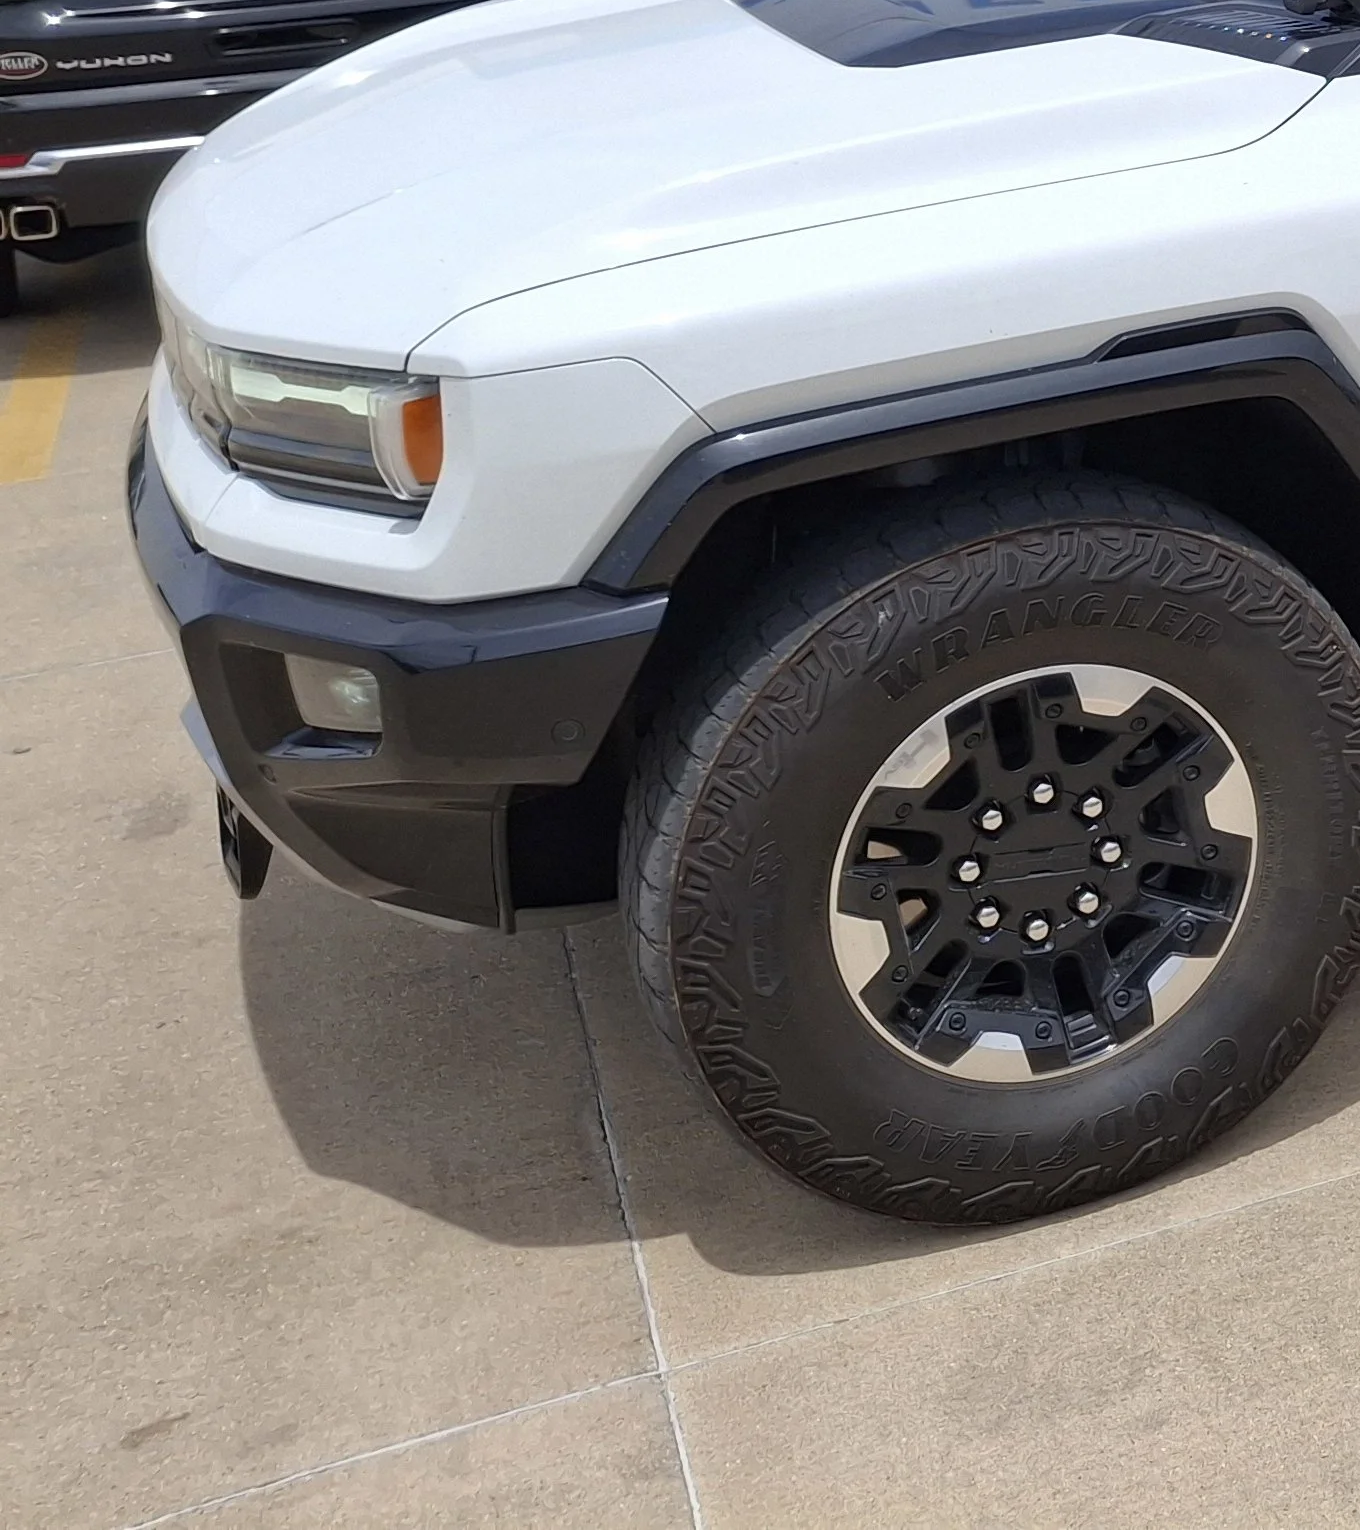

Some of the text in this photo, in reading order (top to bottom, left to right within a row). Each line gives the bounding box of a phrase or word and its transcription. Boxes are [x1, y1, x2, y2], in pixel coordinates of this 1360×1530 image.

[56, 52, 173, 70] YUKON
[873, 591, 1226, 703] WRANGLER
[871, 1033, 1241, 1173] GOODYEAR
